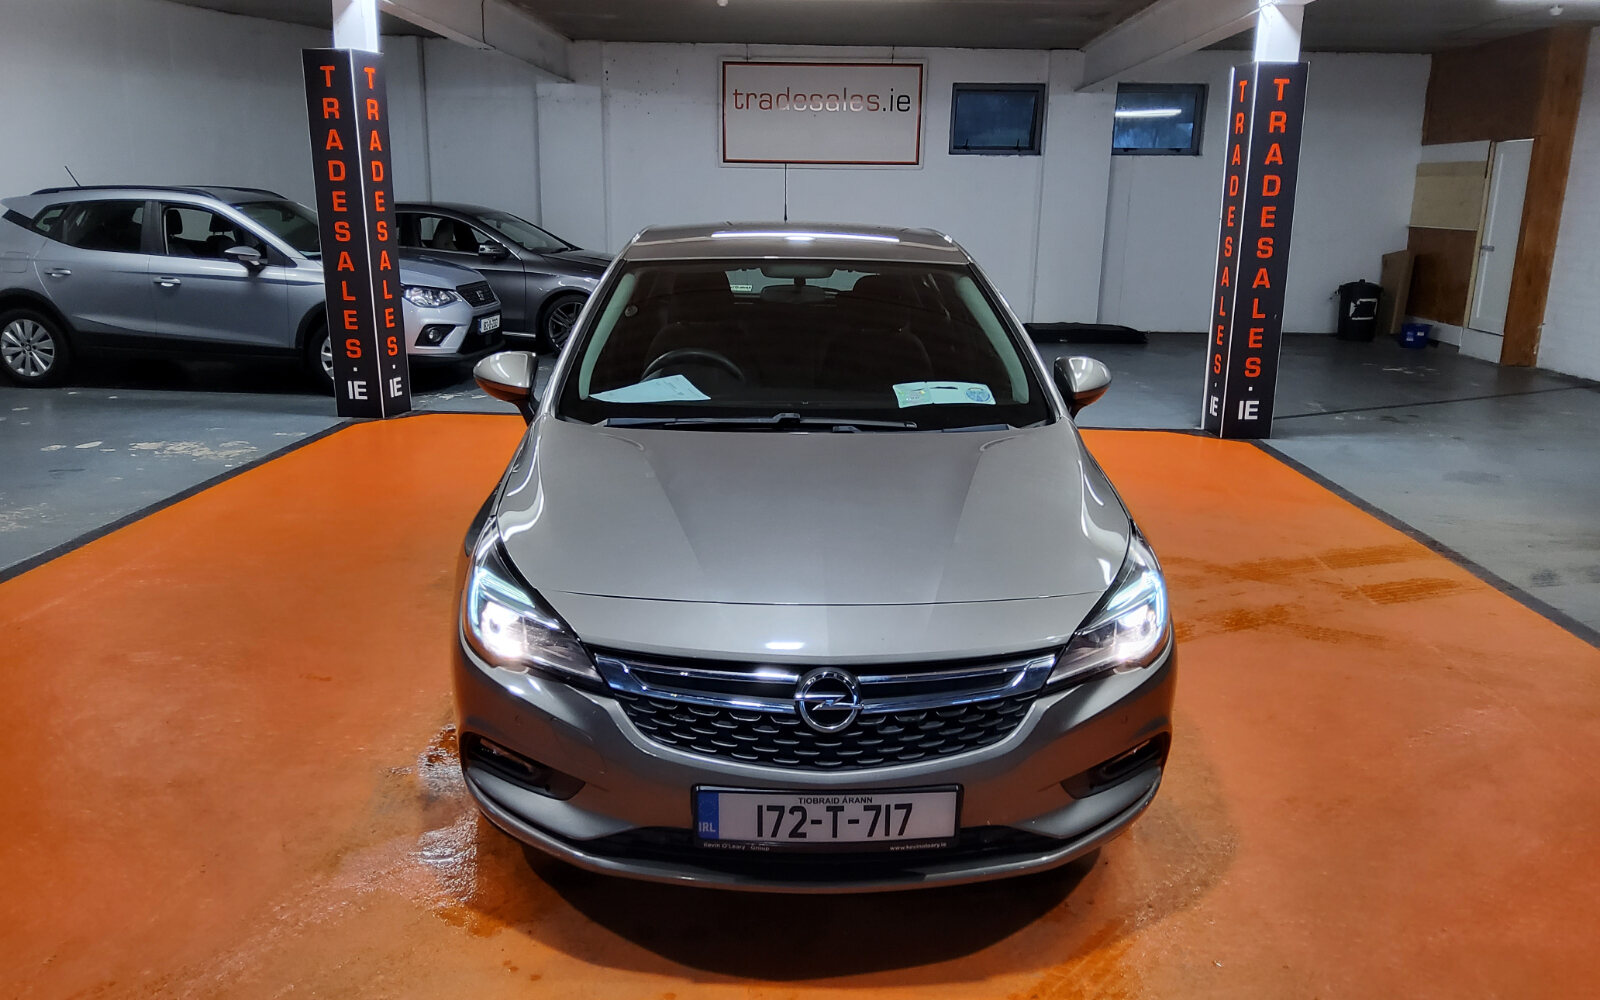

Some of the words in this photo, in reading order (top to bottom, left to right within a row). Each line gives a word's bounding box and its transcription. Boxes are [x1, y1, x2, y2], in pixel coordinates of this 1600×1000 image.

[732, 87, 911, 112] tradesales.ie
[319, 65, 368, 400] TRADESALES.IE
[363, 66, 403, 398] TRADESALES.IE
[1209, 79, 1248, 416] TRADESALES.IE
[1237, 78, 1290, 420] TRADESALES.IE
[698, 821, 716, 832] IRL
[757, 803, 913, 838] 172-T-717
[798, 797, 840, 805] TIOBRAID
[842, 796, 873, 804] ÁRANN
